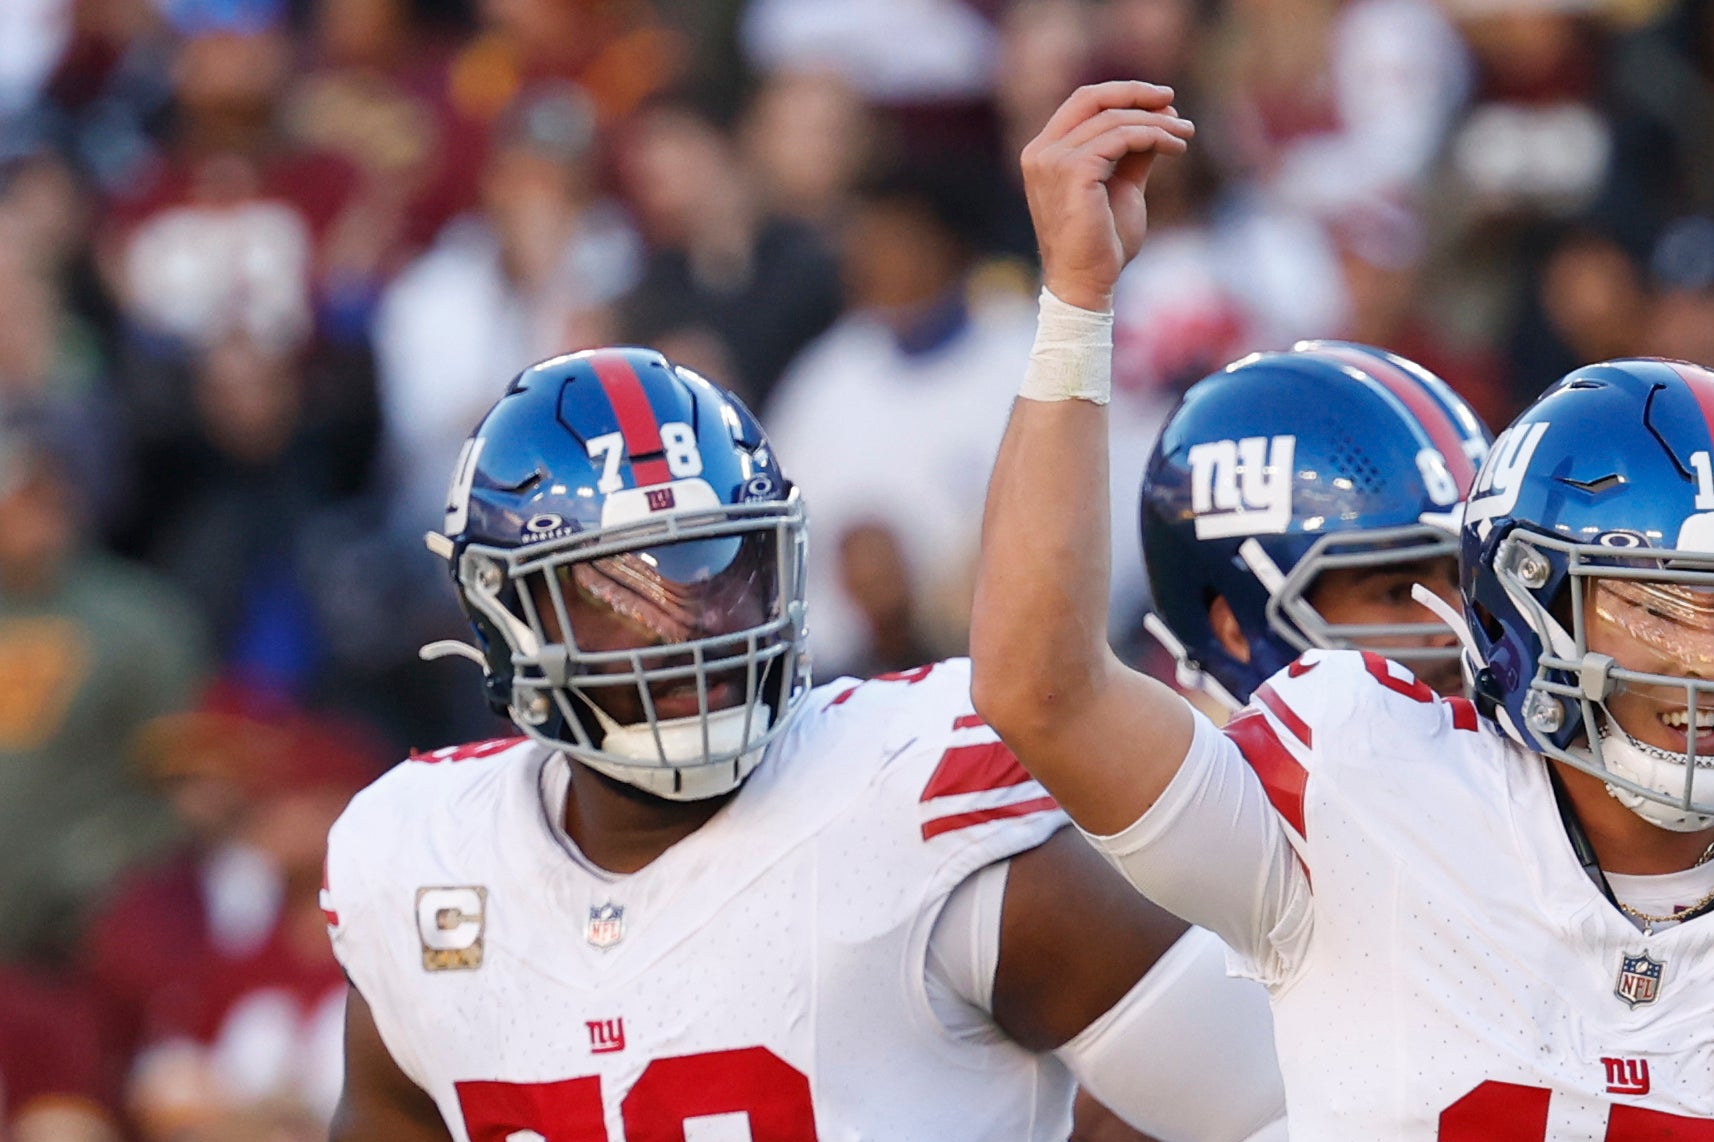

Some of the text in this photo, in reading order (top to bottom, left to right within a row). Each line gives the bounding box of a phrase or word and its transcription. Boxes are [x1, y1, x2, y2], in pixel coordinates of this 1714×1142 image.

[584, 421, 704, 494] 78
[1188, 434, 1296, 541] ny
[417, 888, 484, 950] C
[591, 920, 619, 942] NFL
[1621, 974, 1655, 999] NFL
[585, 1017, 627, 1055] ny
[1600, 1056, 1651, 1096] ny
